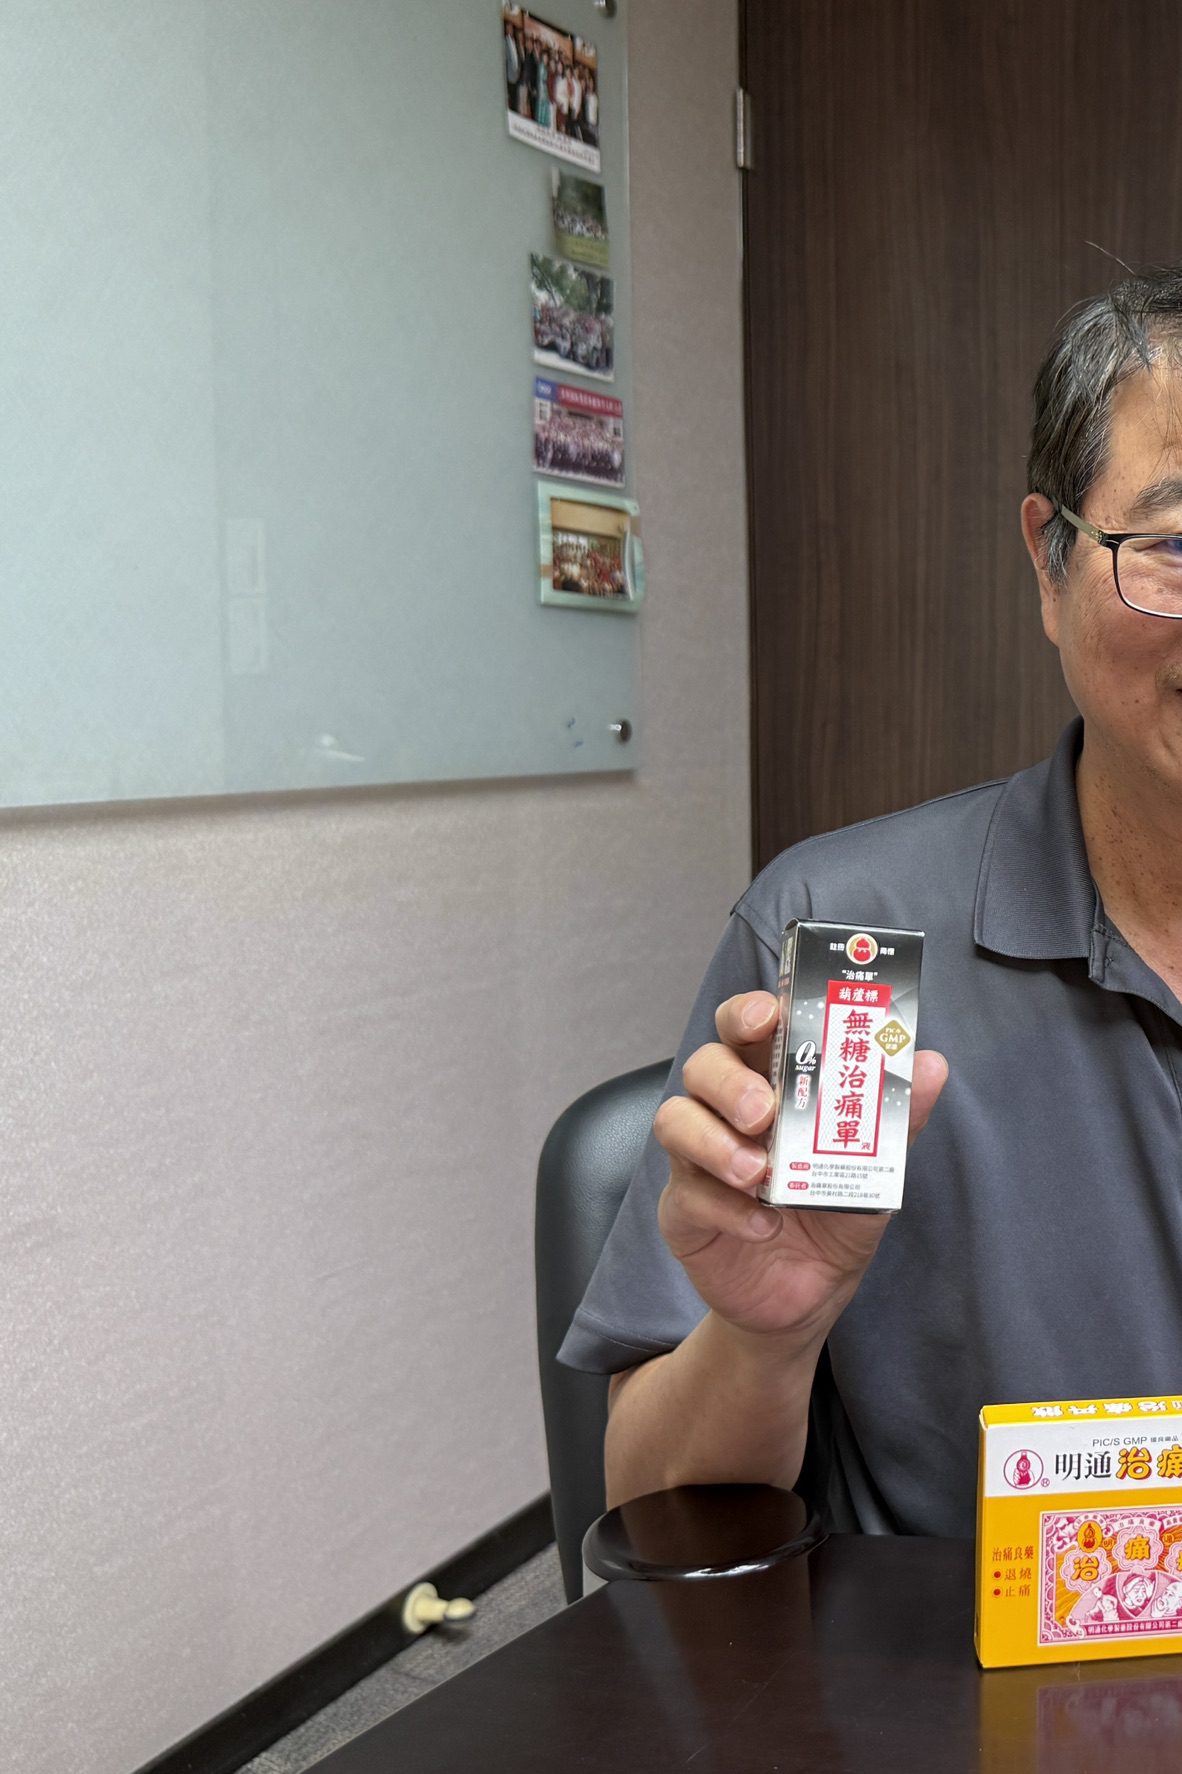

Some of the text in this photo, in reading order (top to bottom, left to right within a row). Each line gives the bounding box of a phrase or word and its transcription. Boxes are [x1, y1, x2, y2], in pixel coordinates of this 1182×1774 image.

[838, 986, 879, 1003] 葫蘆標
[879, 1032, 907, 1044] GMP
[795, 1064, 816, 1073] sugar
[833, 1009, 873, 1149] 無糖治痛單
[795, 1074, 810, 1110] 新配方
[1092, 1437, 1120, 1447] PIC/S
[1123, 1436, 1148, 1446] GMP
[1072, 1556, 1099, 1581] 治
[1124, 1535, 1150, 1561] 痛
